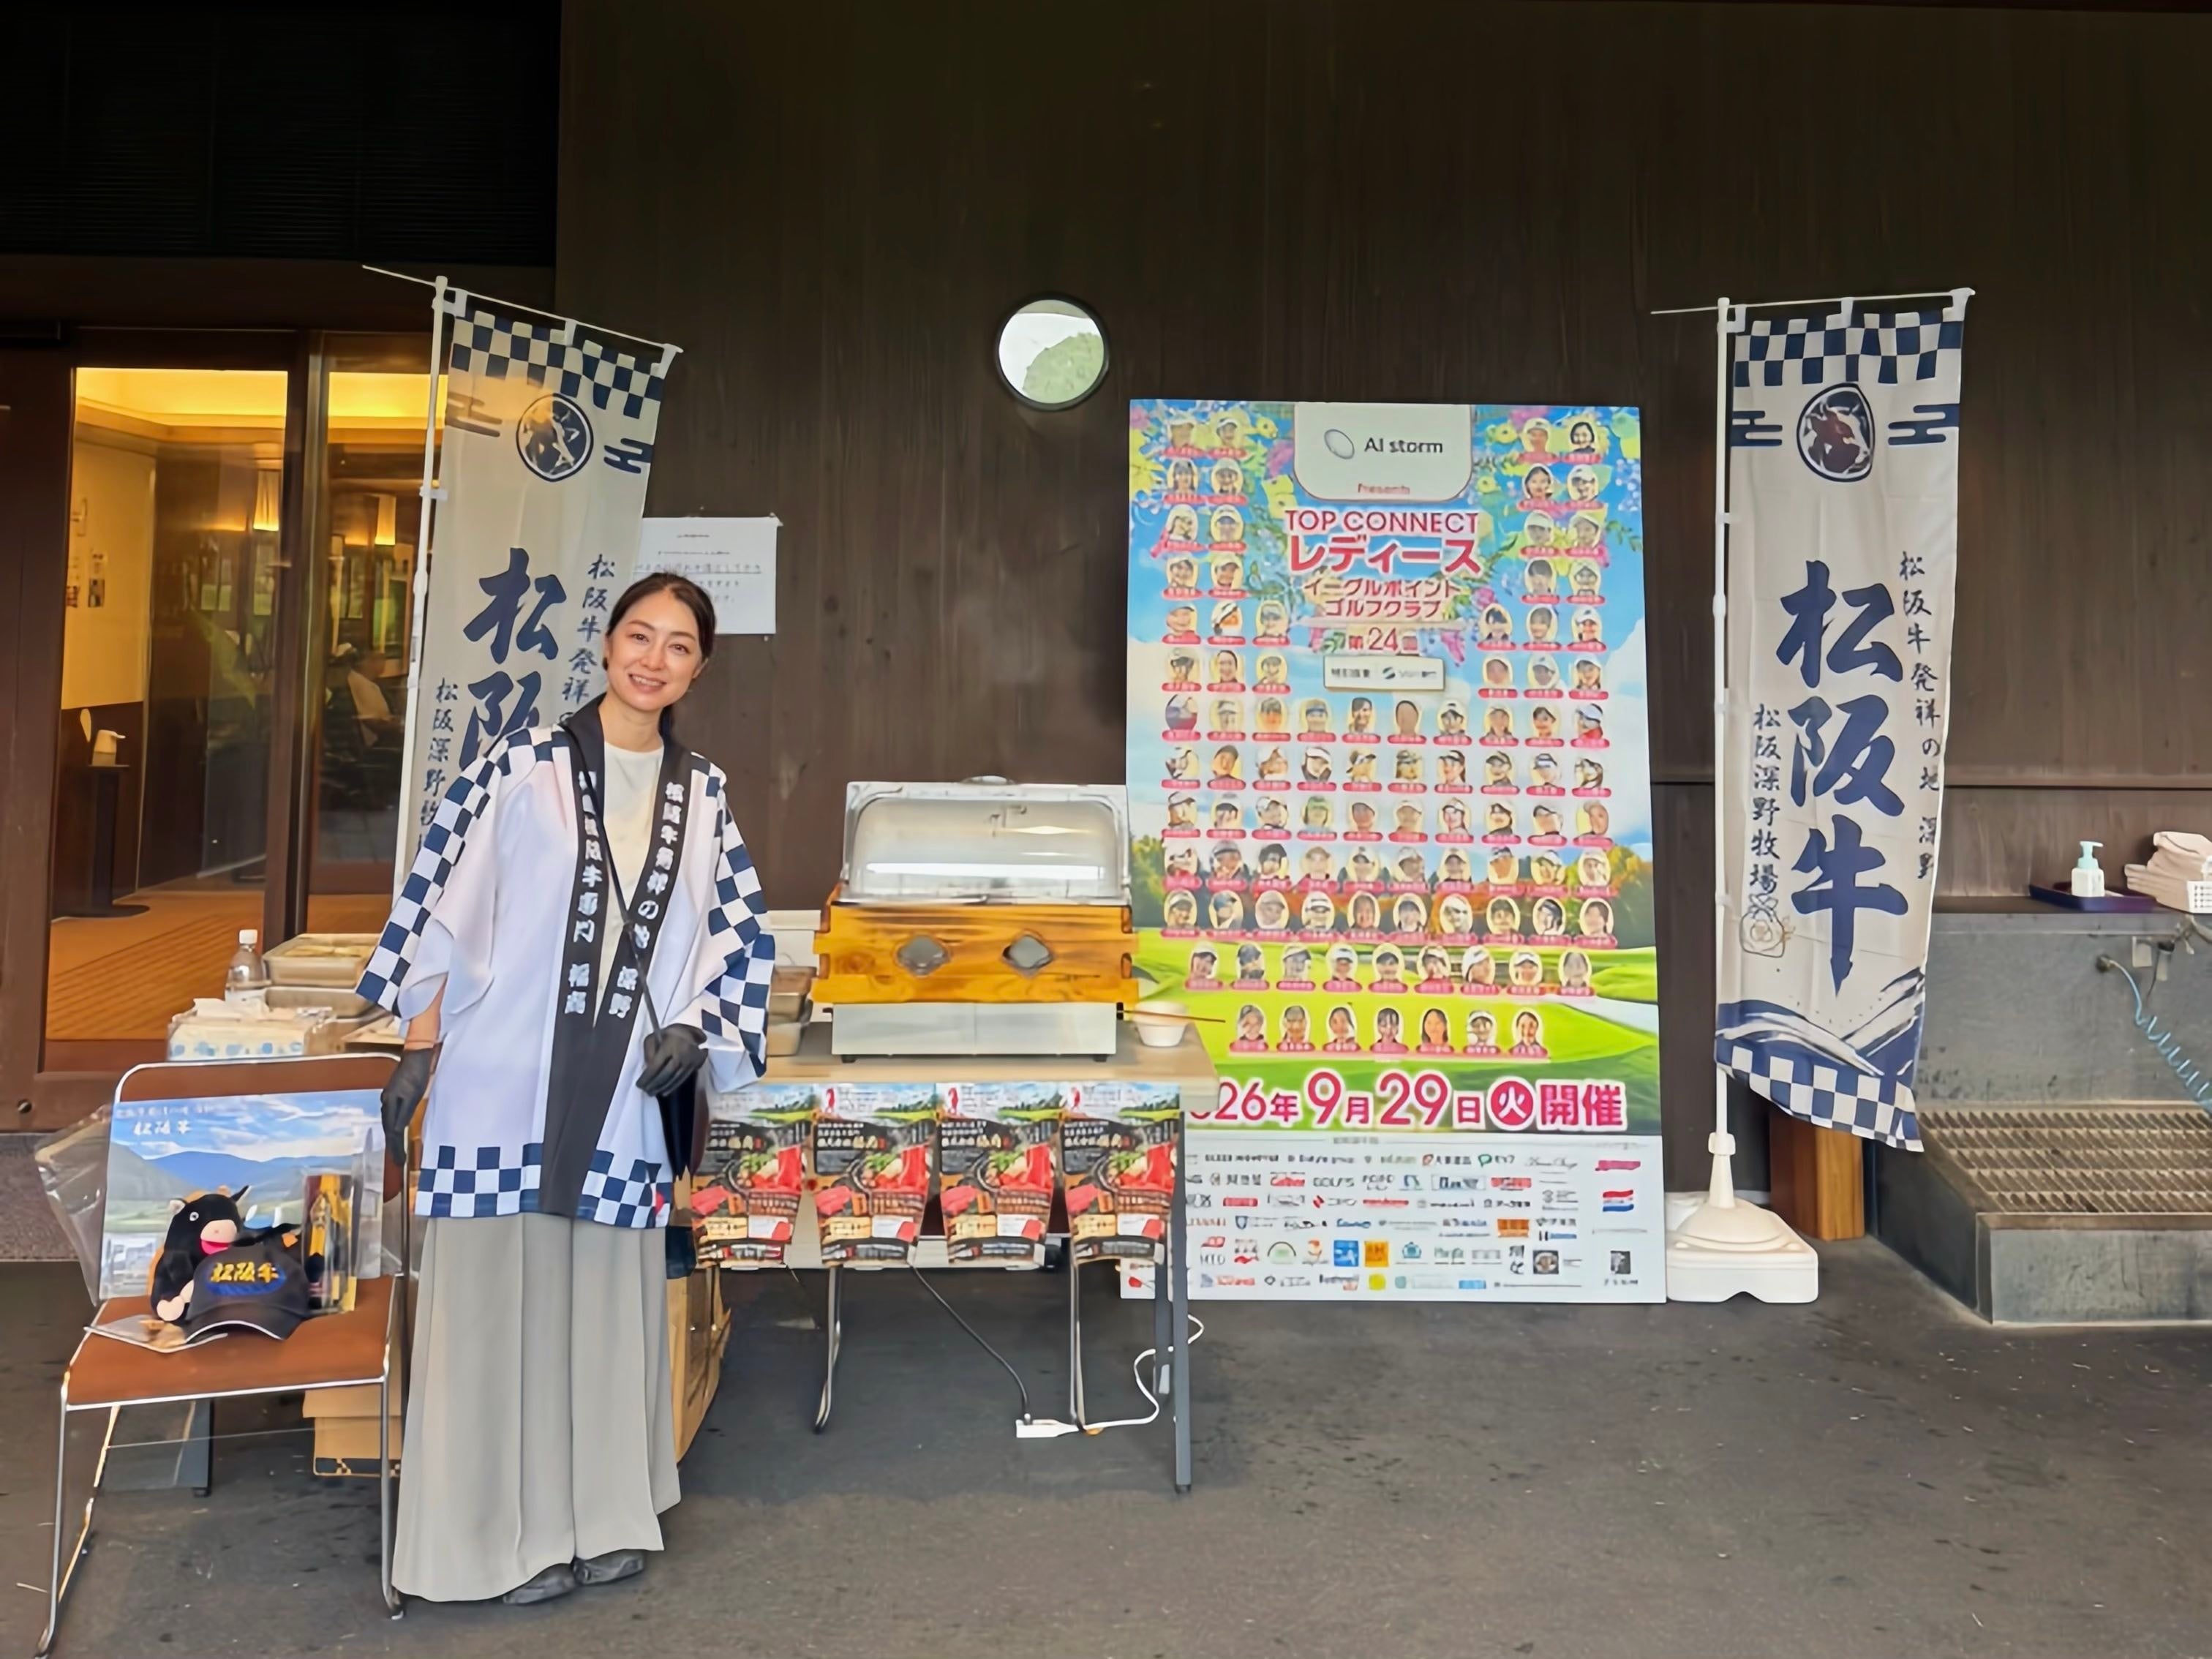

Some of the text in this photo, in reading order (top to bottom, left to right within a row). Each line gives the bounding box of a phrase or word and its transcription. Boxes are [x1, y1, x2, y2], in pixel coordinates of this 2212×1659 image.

[1363, 437, 1443, 454] AI storm
[1284, 510, 1479, 533] TOP CONNECT
[1290, 535, 1481, 573] レディース
[1325, 600, 1441, 618] ゴルフクラブ
[1775, 560, 1908, 998] 松阪牛
[1750, 704, 1781, 894] 松阪深野牧場
